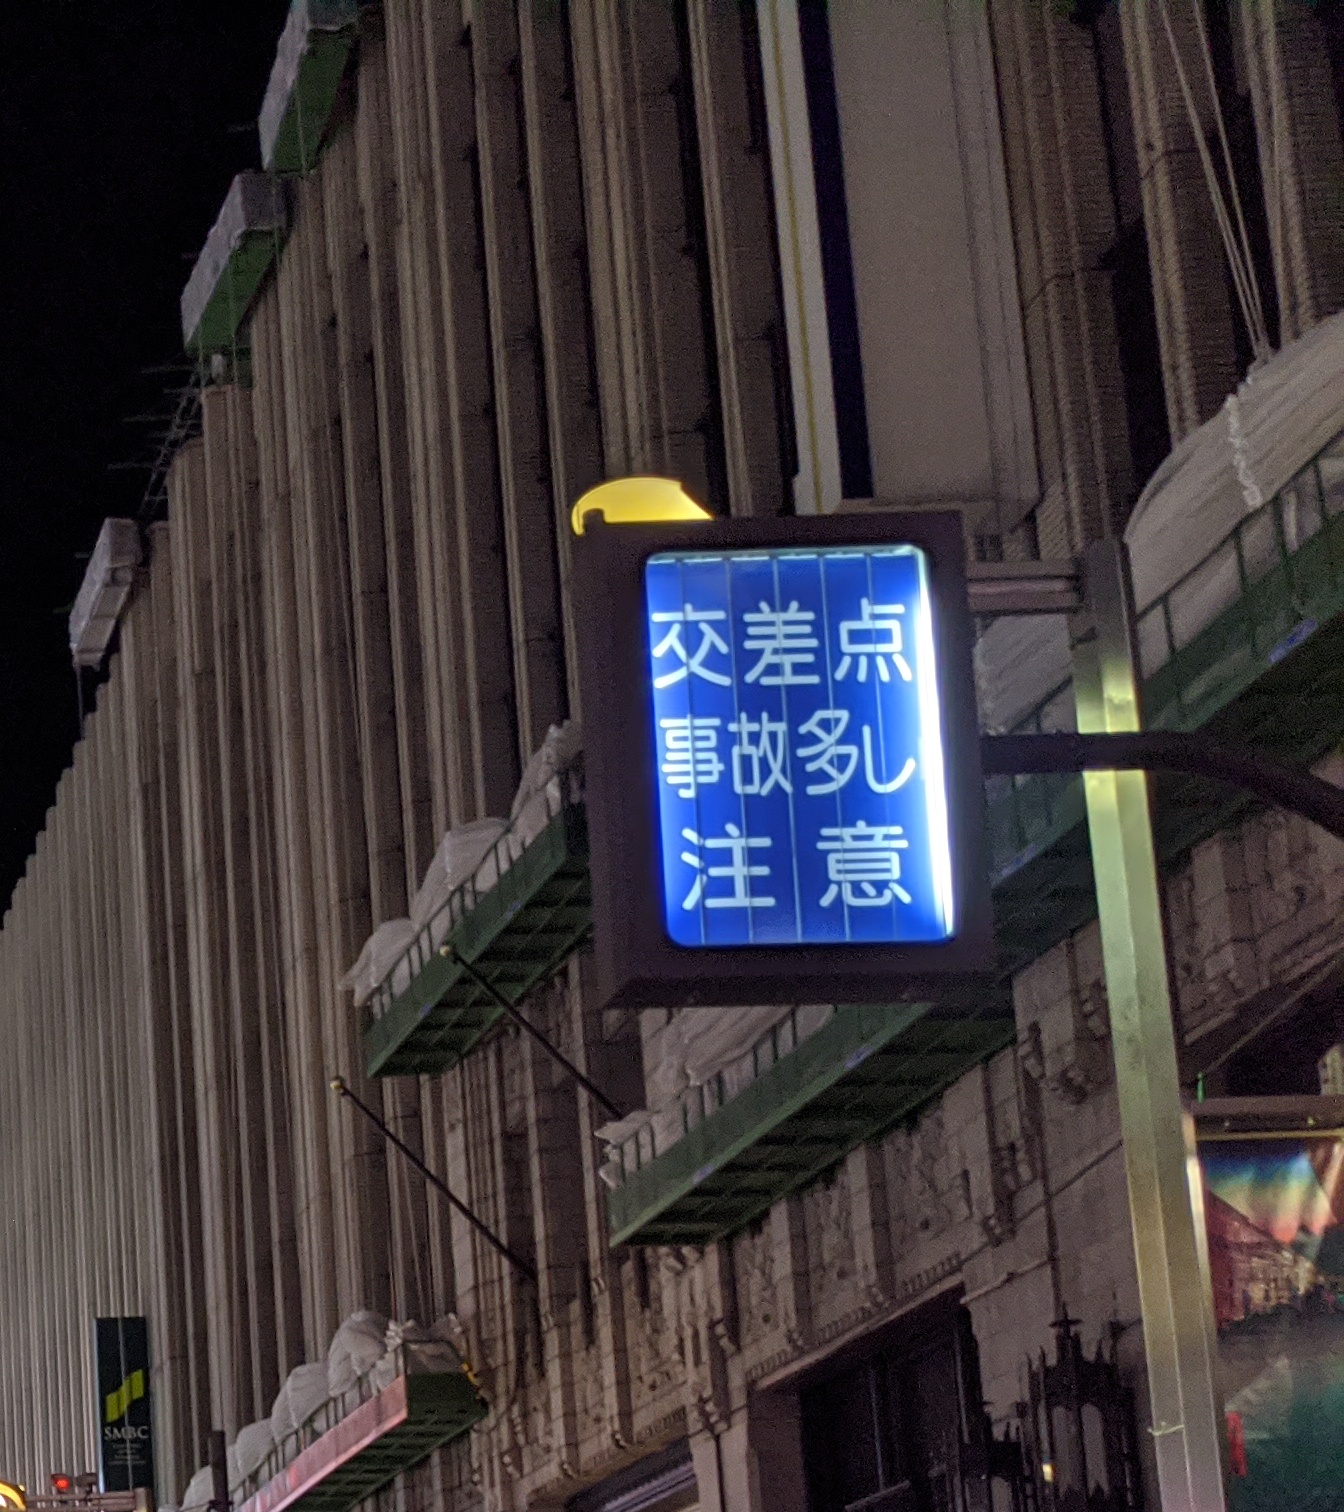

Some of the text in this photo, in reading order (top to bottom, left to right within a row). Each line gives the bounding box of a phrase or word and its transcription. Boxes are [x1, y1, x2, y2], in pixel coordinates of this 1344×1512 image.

[650, 597, 914, 689] 交差点
[658, 708, 917, 800] 事故多し
[678, 820, 914, 912] 注意
[104, 1425, 150, 1441] SMBC
